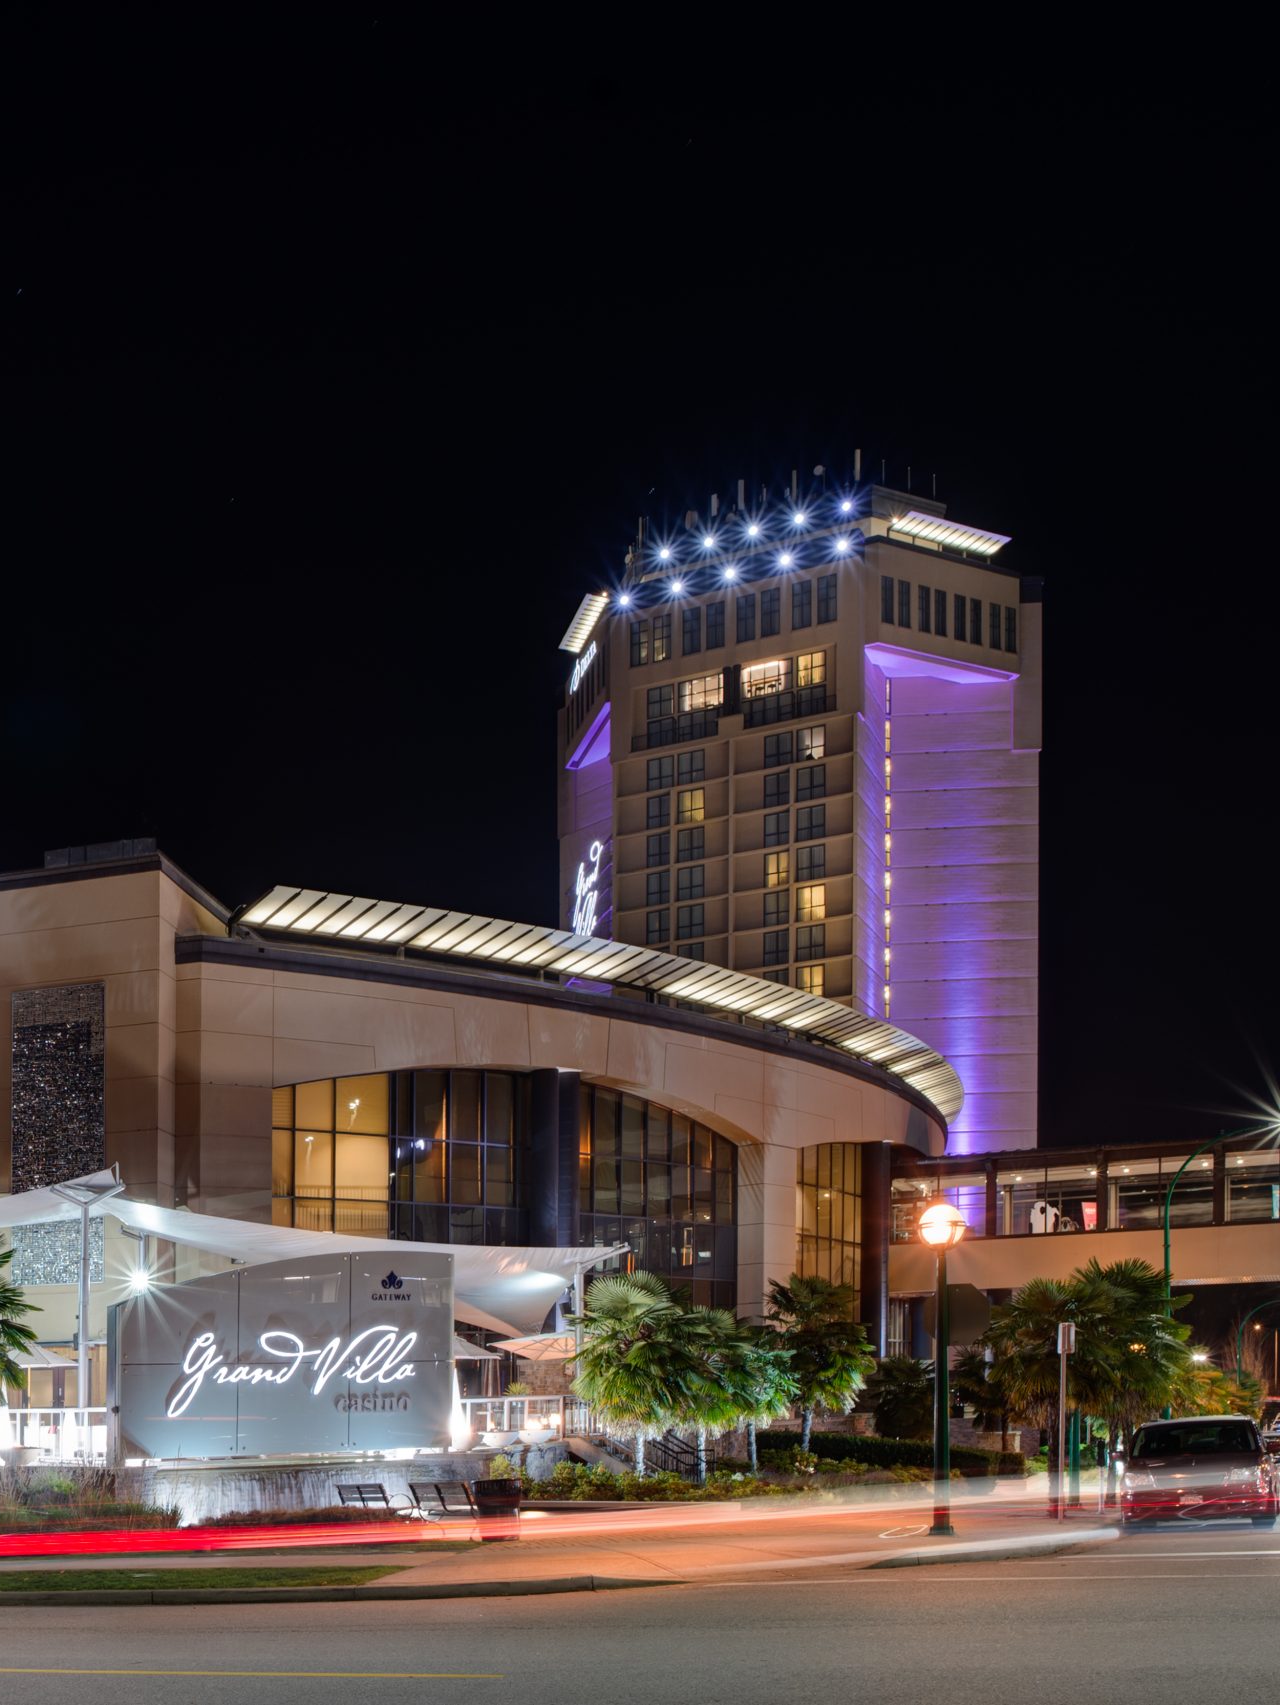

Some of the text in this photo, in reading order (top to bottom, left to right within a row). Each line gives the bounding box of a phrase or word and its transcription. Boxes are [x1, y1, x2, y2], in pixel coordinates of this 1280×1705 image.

[371, 1293, 411, 1301] GATEWAY
[167, 1324, 418, 1418] Grand Villa
